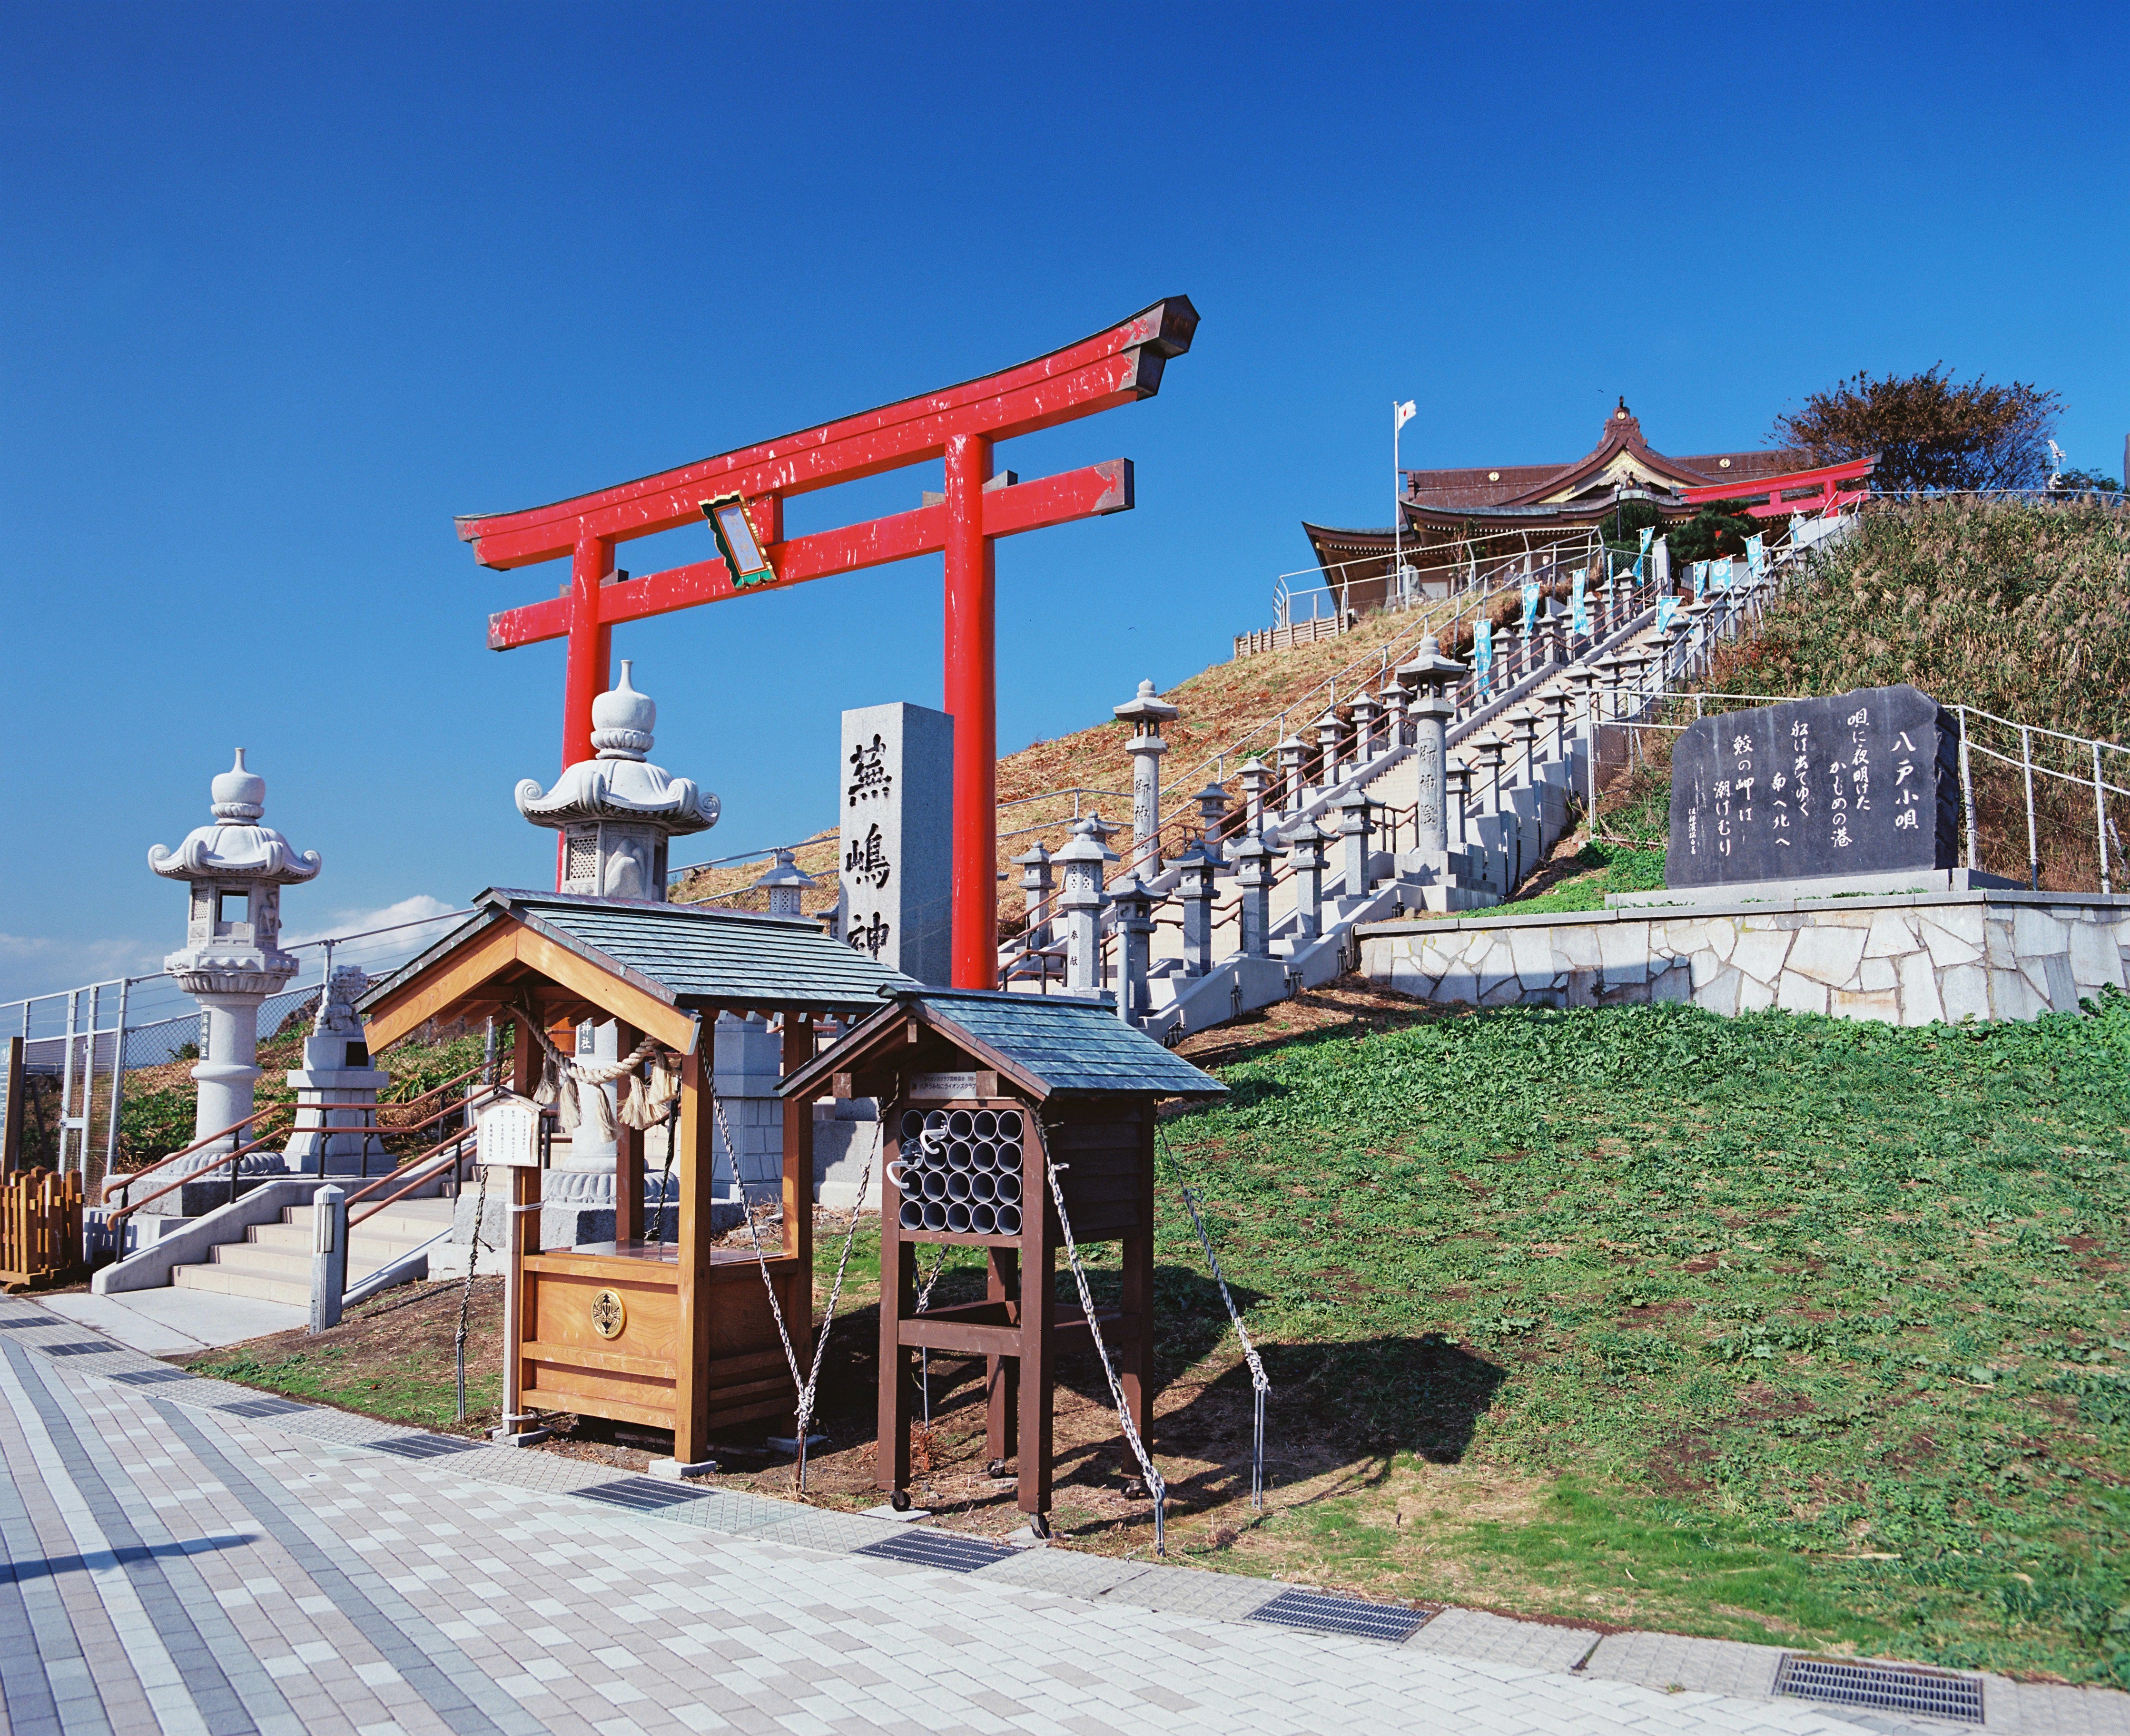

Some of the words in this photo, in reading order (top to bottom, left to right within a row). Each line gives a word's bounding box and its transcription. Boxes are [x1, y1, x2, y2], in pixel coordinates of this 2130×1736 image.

[1733, 735, 1755, 822] 鮫の岬は
[1847, 708, 1871, 811] 唄に夜明けた
[1891, 732, 1919, 830] 八戸小唄
[1713, 782, 1731, 856] 潮けむり
[1771, 772, 1790, 846] 南へ北へ
[1829, 761, 1853, 848] かもめの港
[1070, 930, 1079, 966] 奉献
[580, 1017, 592, 1049] 神社
